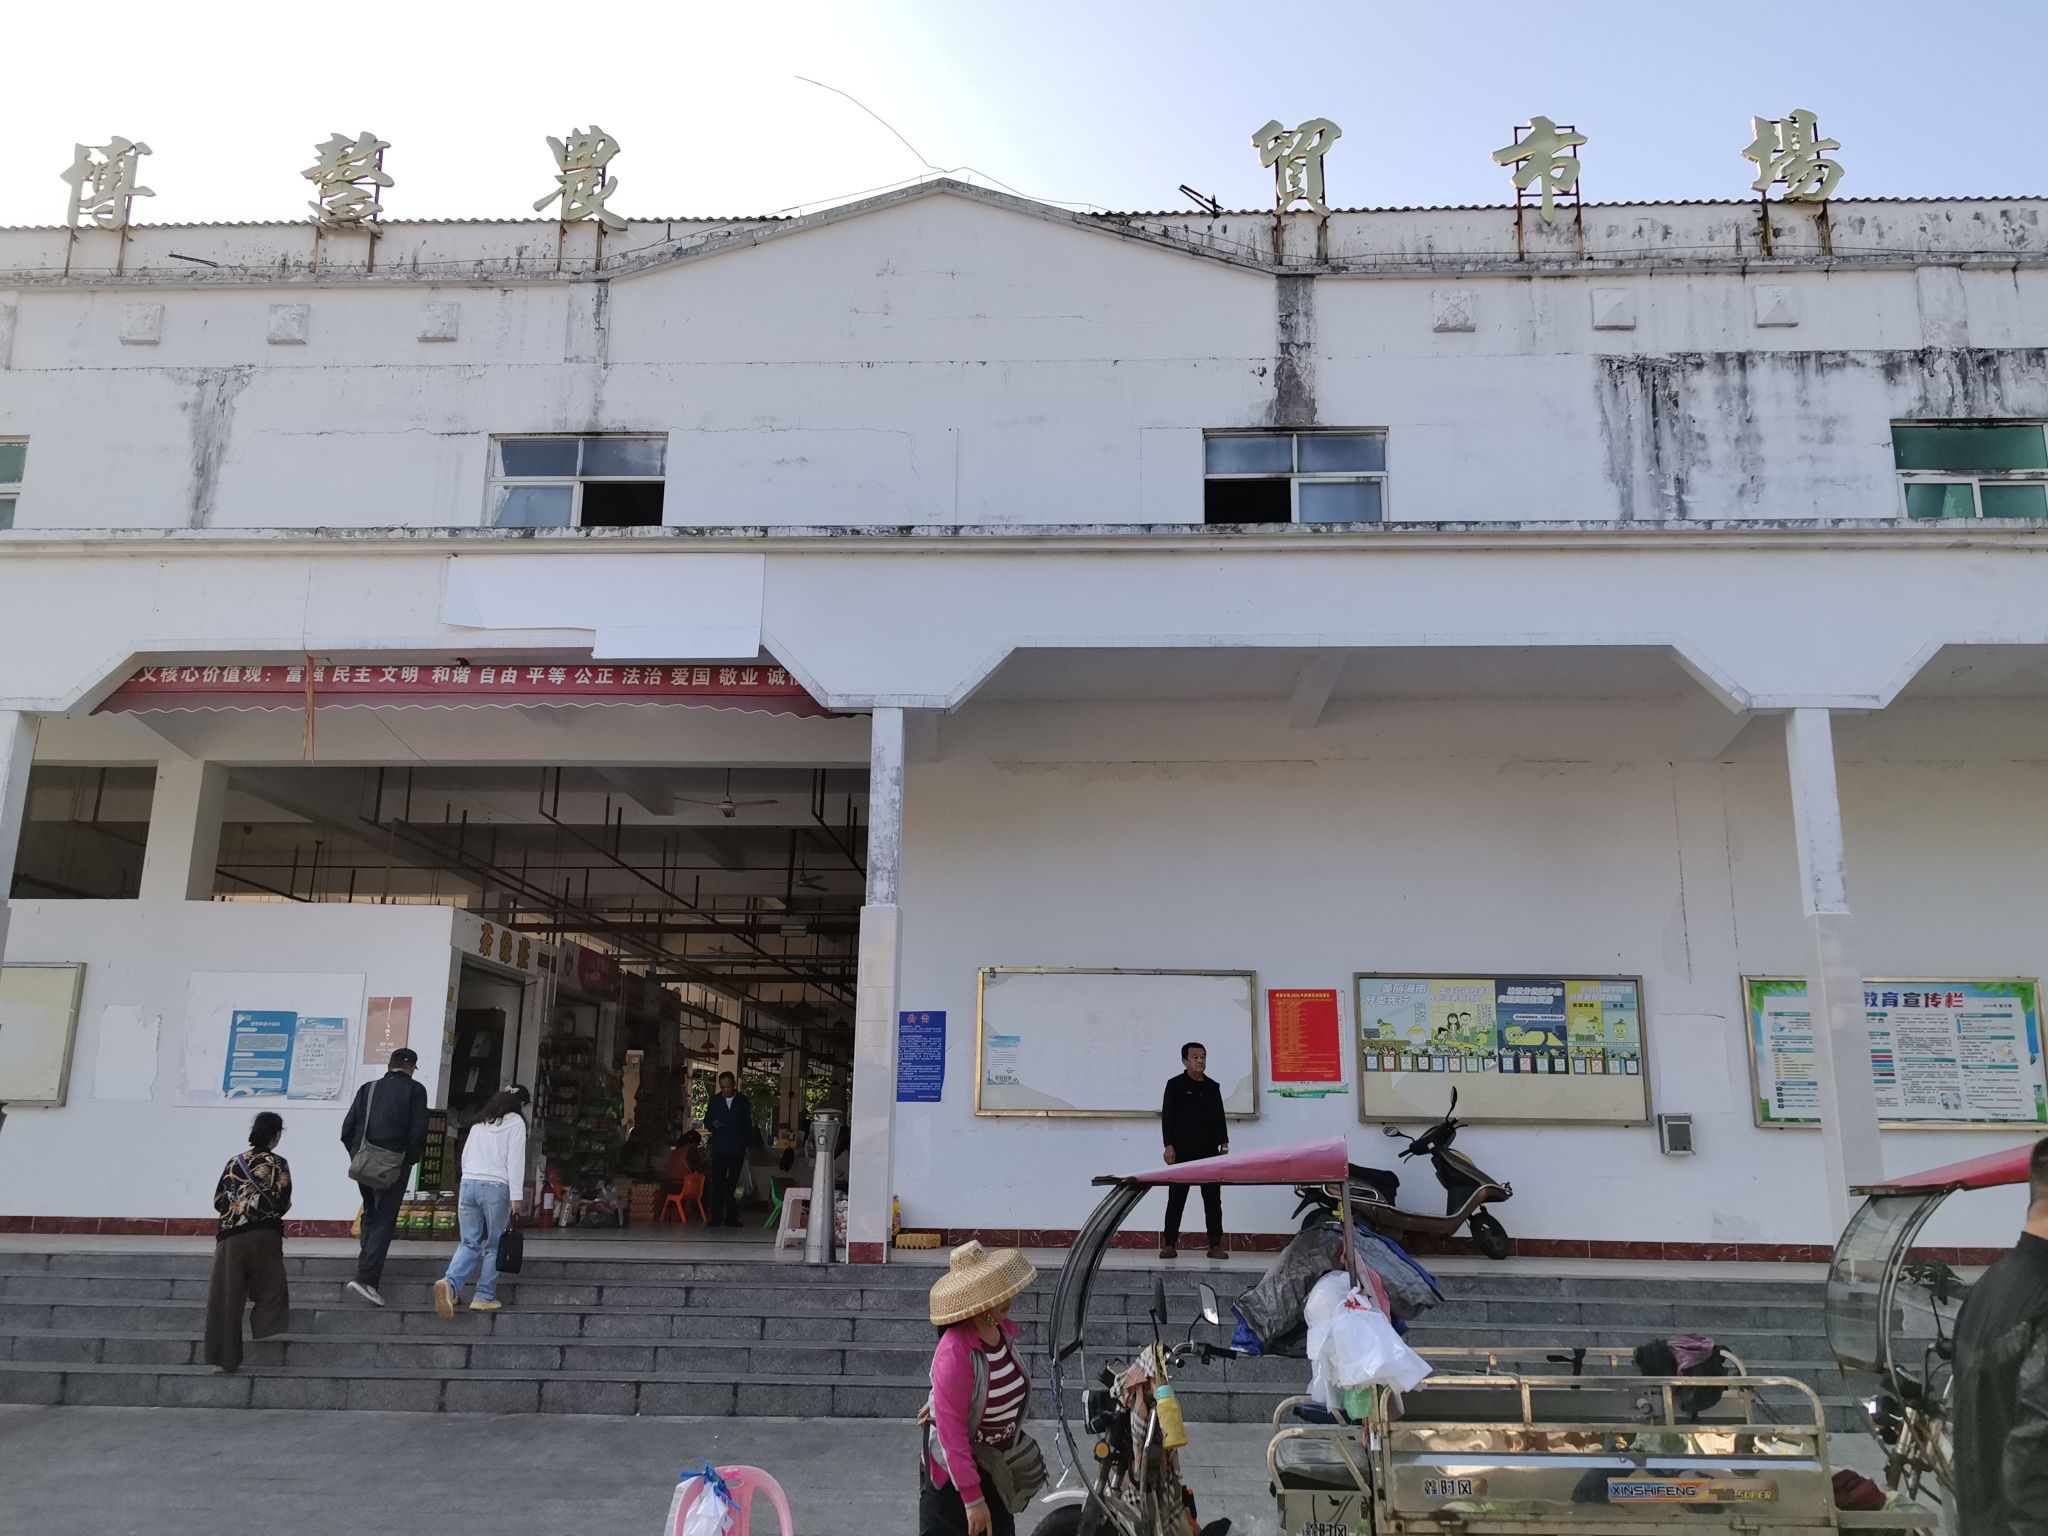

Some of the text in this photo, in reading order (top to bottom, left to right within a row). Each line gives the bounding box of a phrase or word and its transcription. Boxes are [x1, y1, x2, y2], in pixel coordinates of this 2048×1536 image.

[128, 666, 271, 682] 义核心价值观：
[332, 666, 371, 683] 民主
[379, 666, 419, 683] 文明
[431, 666, 472, 684] 和谐
[479, 667, 518, 684] 自由
[526, 667, 567, 684] 平等
[574, 667, 614, 685] 公正
[621, 667, 662, 685] 法治
[670, 667, 711, 686] 爱国
[719, 667, 759, 686] 敬业
[1864, 991, 1964, 1008] 教育宣传栏
[1611, 1486, 1696, 1496] XINSHIFENG
